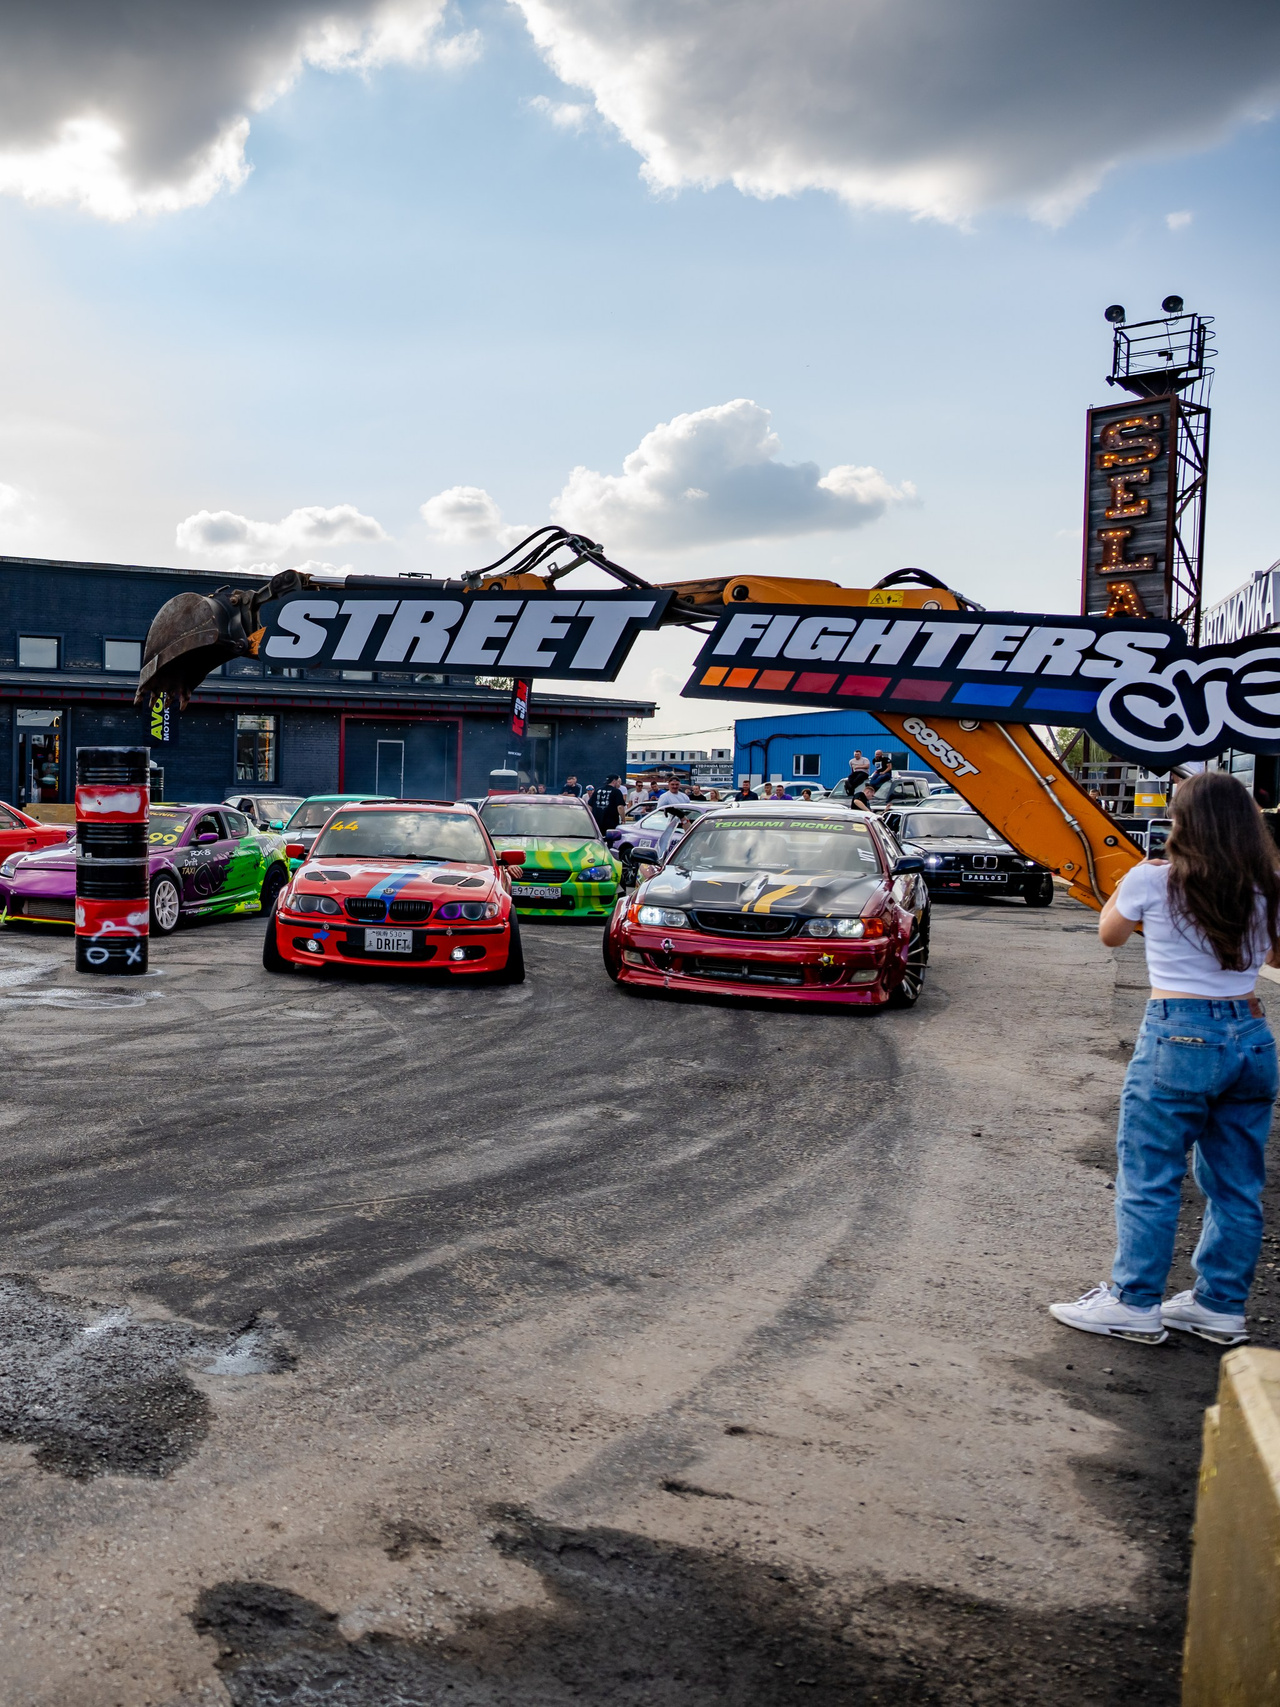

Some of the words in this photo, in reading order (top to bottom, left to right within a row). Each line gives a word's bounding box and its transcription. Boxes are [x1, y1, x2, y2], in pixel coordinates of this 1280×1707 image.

[265, 599, 658, 670] STREET
[712, 613, 1170, 679] FIGHTERS
[902, 716, 981, 777] 695ST
[330, 820, 359, 831] 44
[715, 821, 785, 829] TSUNAMI
[790, 821, 845, 831] PICNIC
[149, 832, 177, 845] 99
[184, 857, 198, 867] Drift
[182, 867, 196, 875] TAXI
[376, 938, 409, 951] DRIFT
